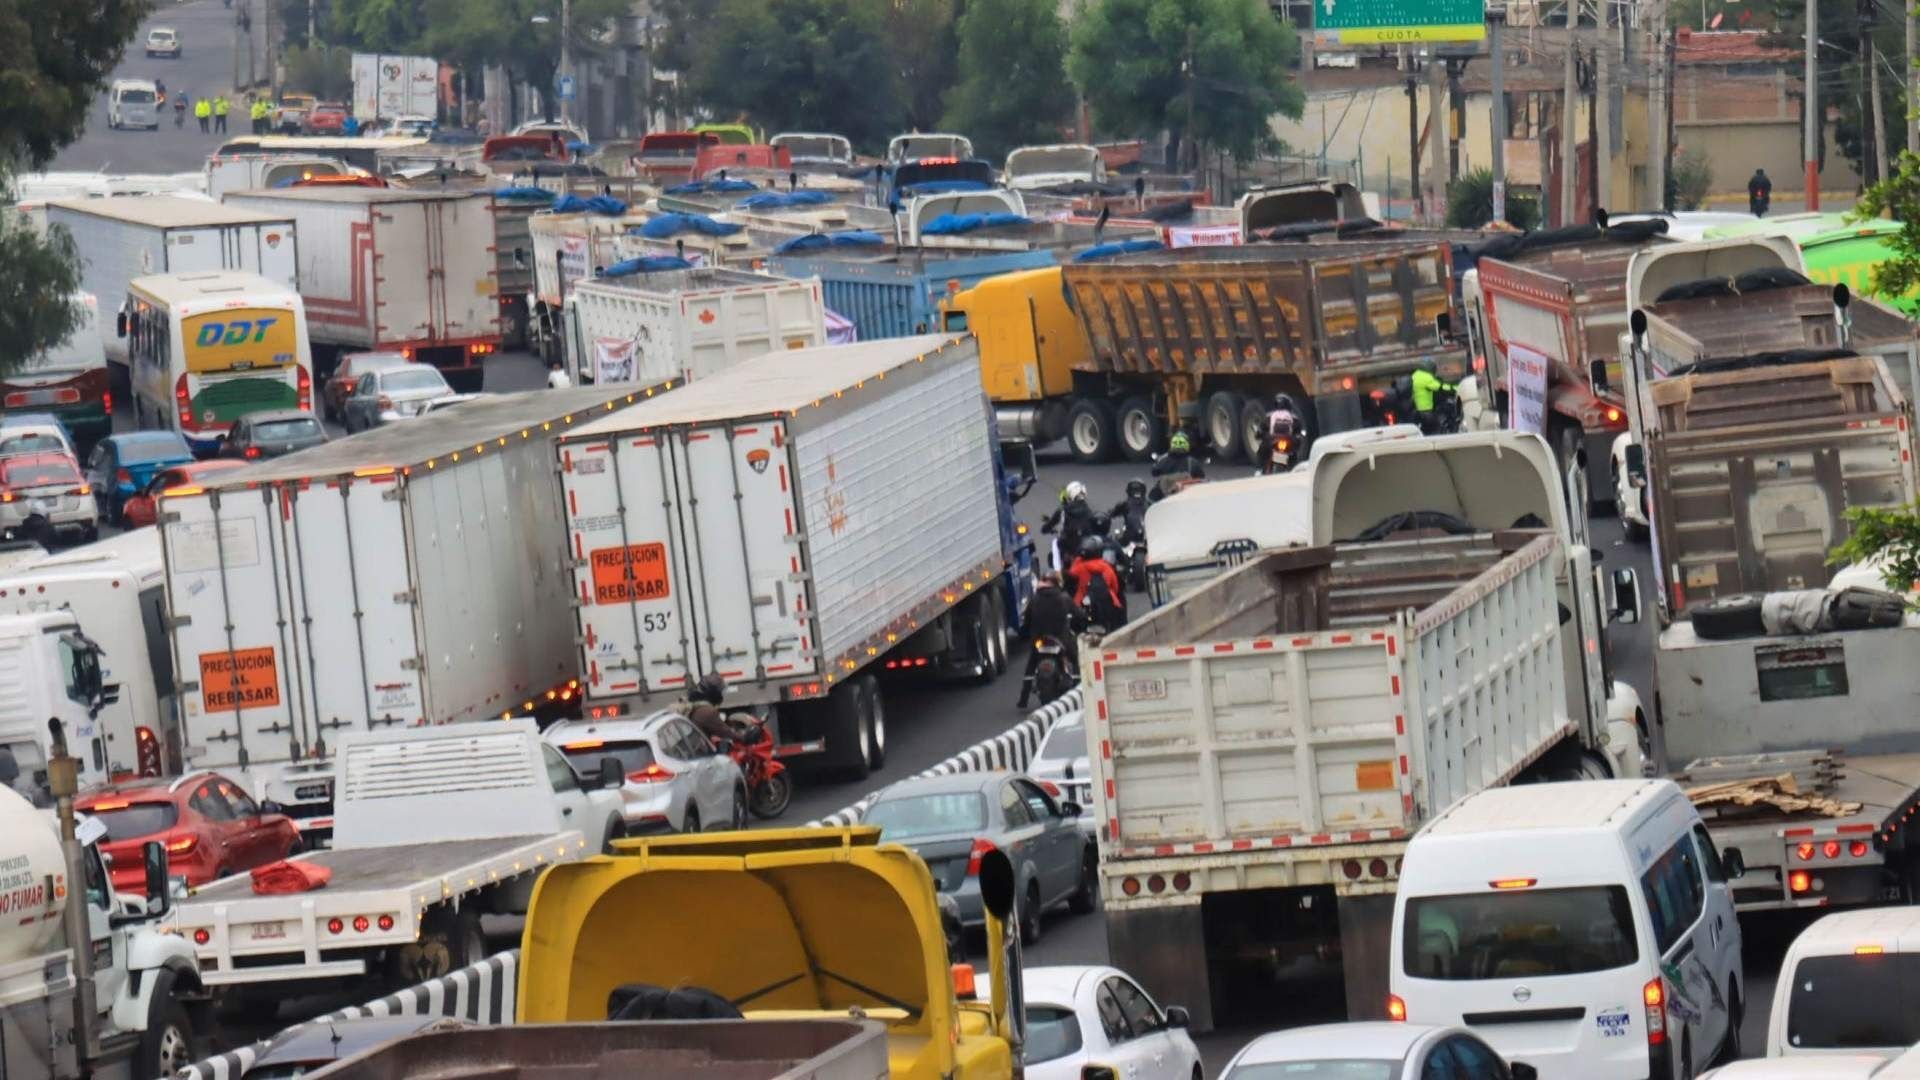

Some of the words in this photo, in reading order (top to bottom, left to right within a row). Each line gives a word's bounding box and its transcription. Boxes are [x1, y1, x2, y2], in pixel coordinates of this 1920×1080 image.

[1376, 31, 1422, 40] CUOTA
[196, 318, 277, 347] DDT
[598, 579, 664, 600] REBASAR
[230, 674, 249, 687] AL
[207, 686, 275, 706] REBASAR
[12, 884, 44, 912] FUMAR
